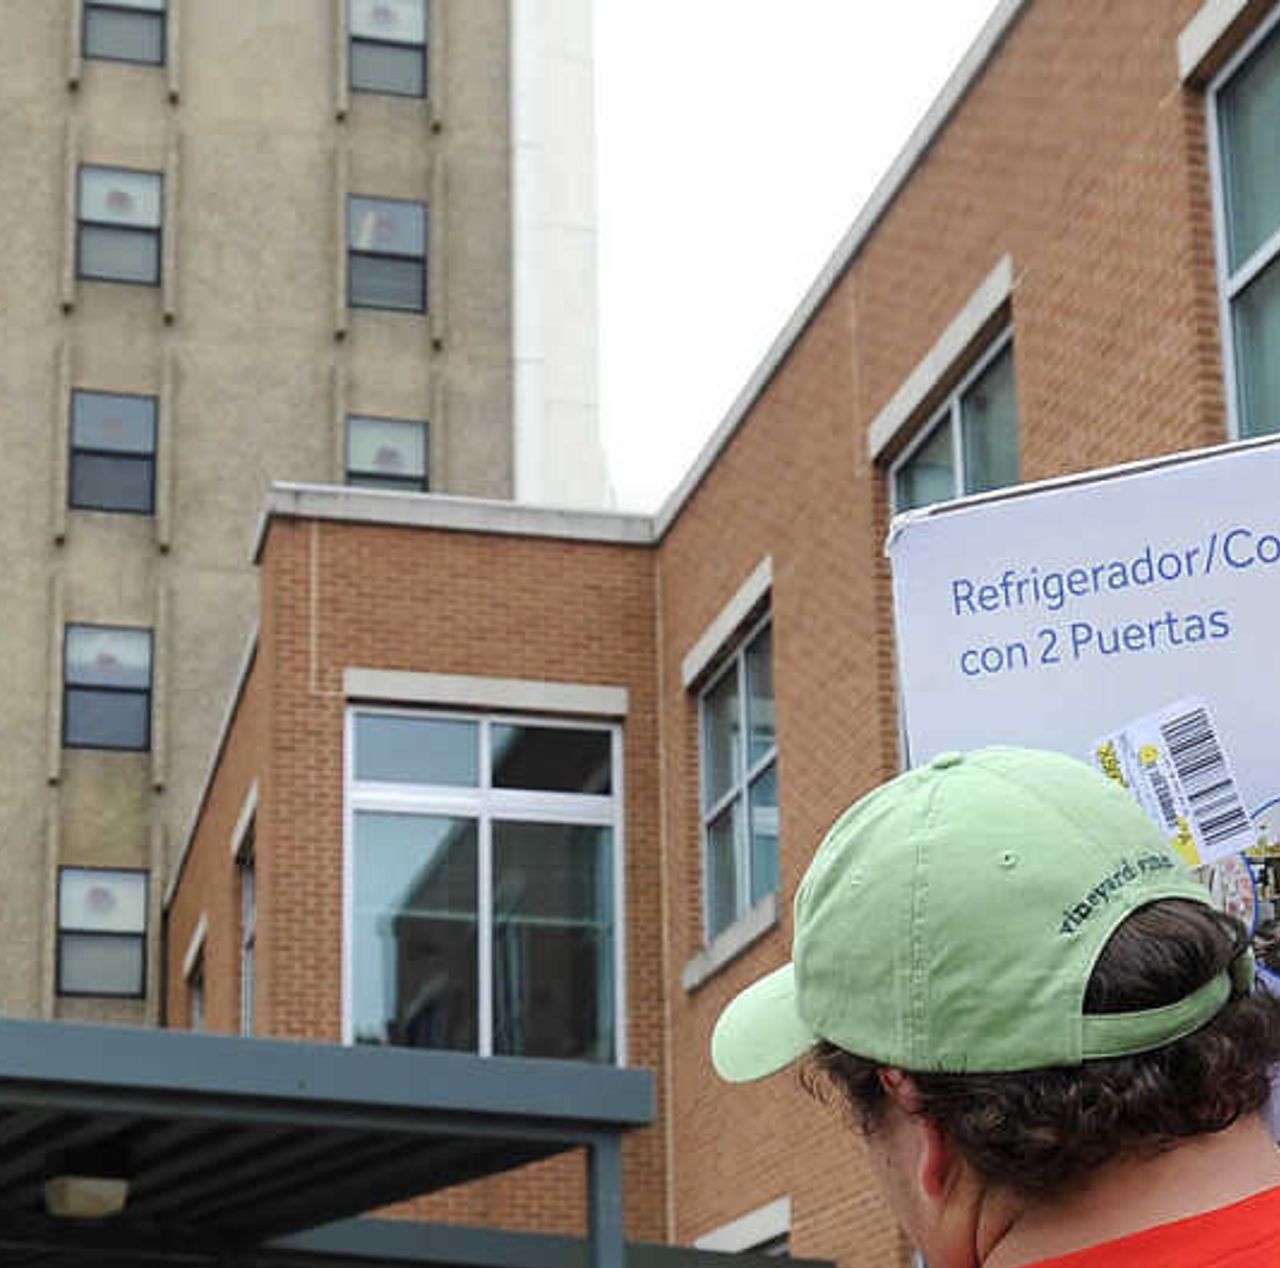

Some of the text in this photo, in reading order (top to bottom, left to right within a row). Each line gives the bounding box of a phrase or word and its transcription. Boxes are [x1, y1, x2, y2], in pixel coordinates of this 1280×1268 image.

[961, 606, 1230, 675] con 2 Puertas
